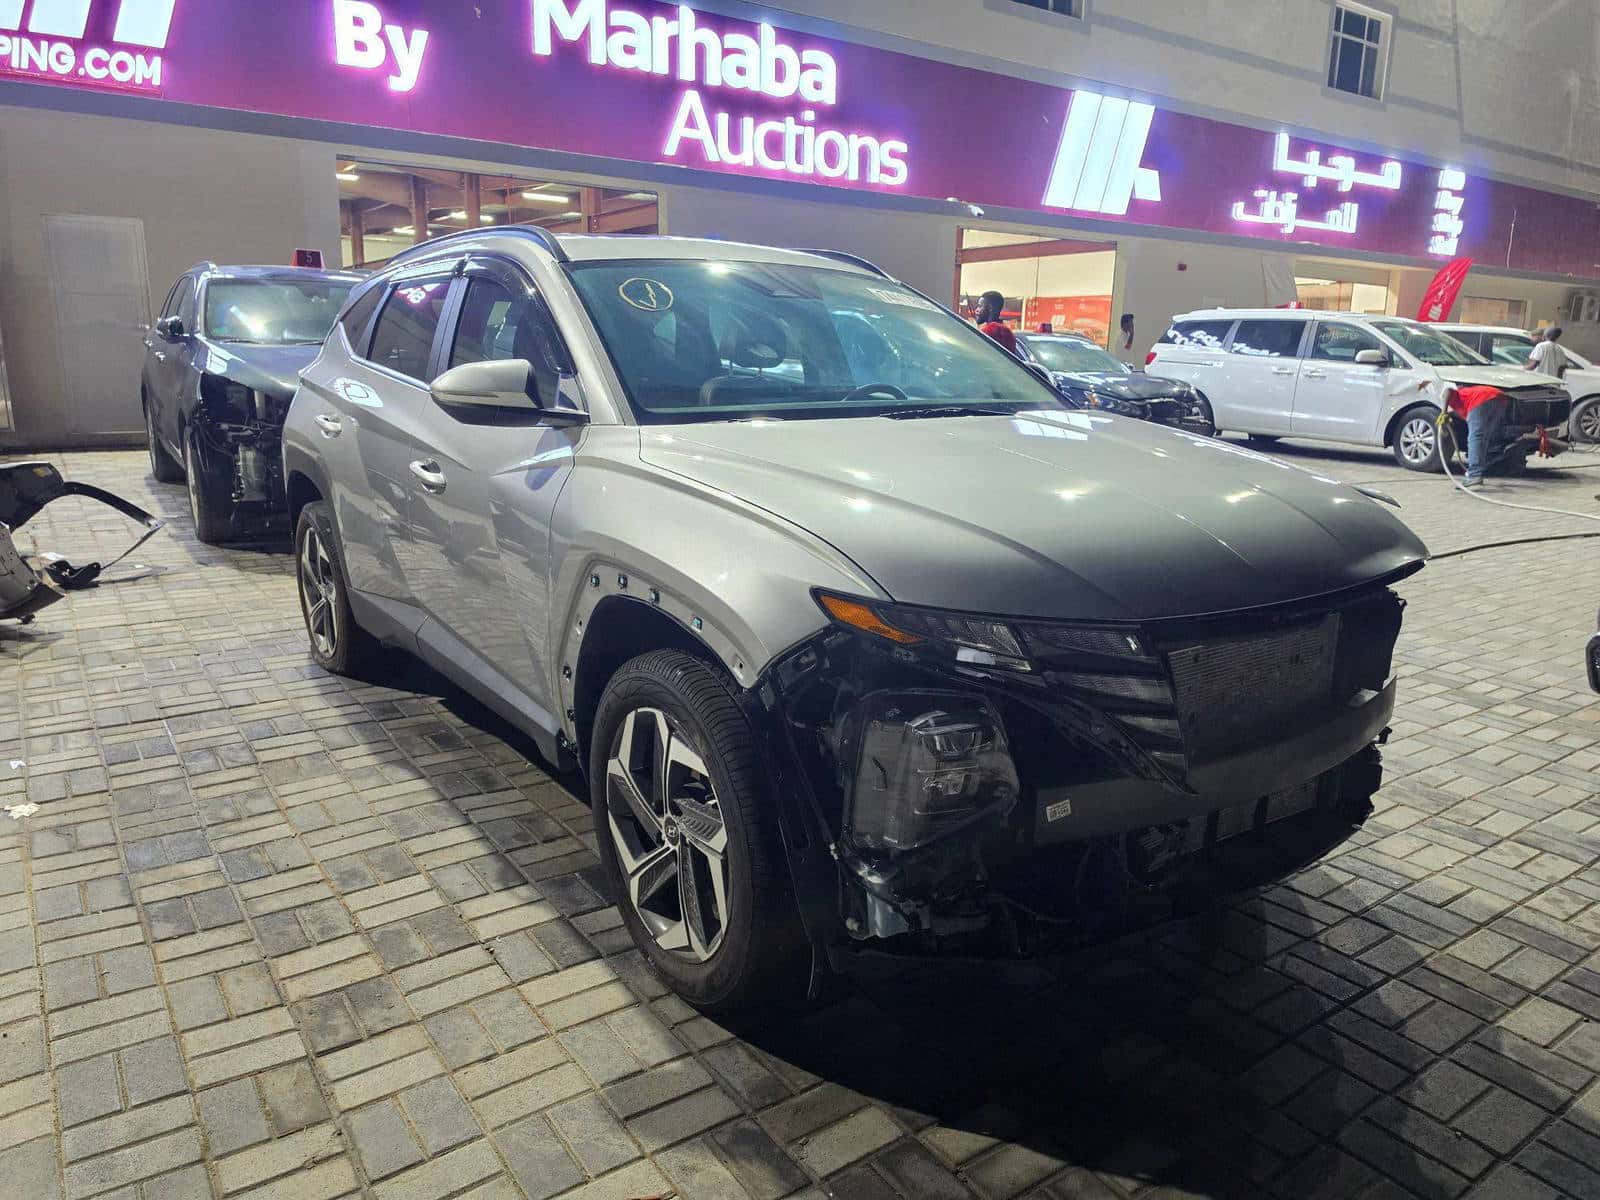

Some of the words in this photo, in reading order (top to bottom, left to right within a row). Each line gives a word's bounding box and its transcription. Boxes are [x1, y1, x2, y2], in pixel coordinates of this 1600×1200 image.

[333, 0, 429, 92] By
[531, 0, 837, 105] Marhaba
[663, 90, 909, 186] Auctions
